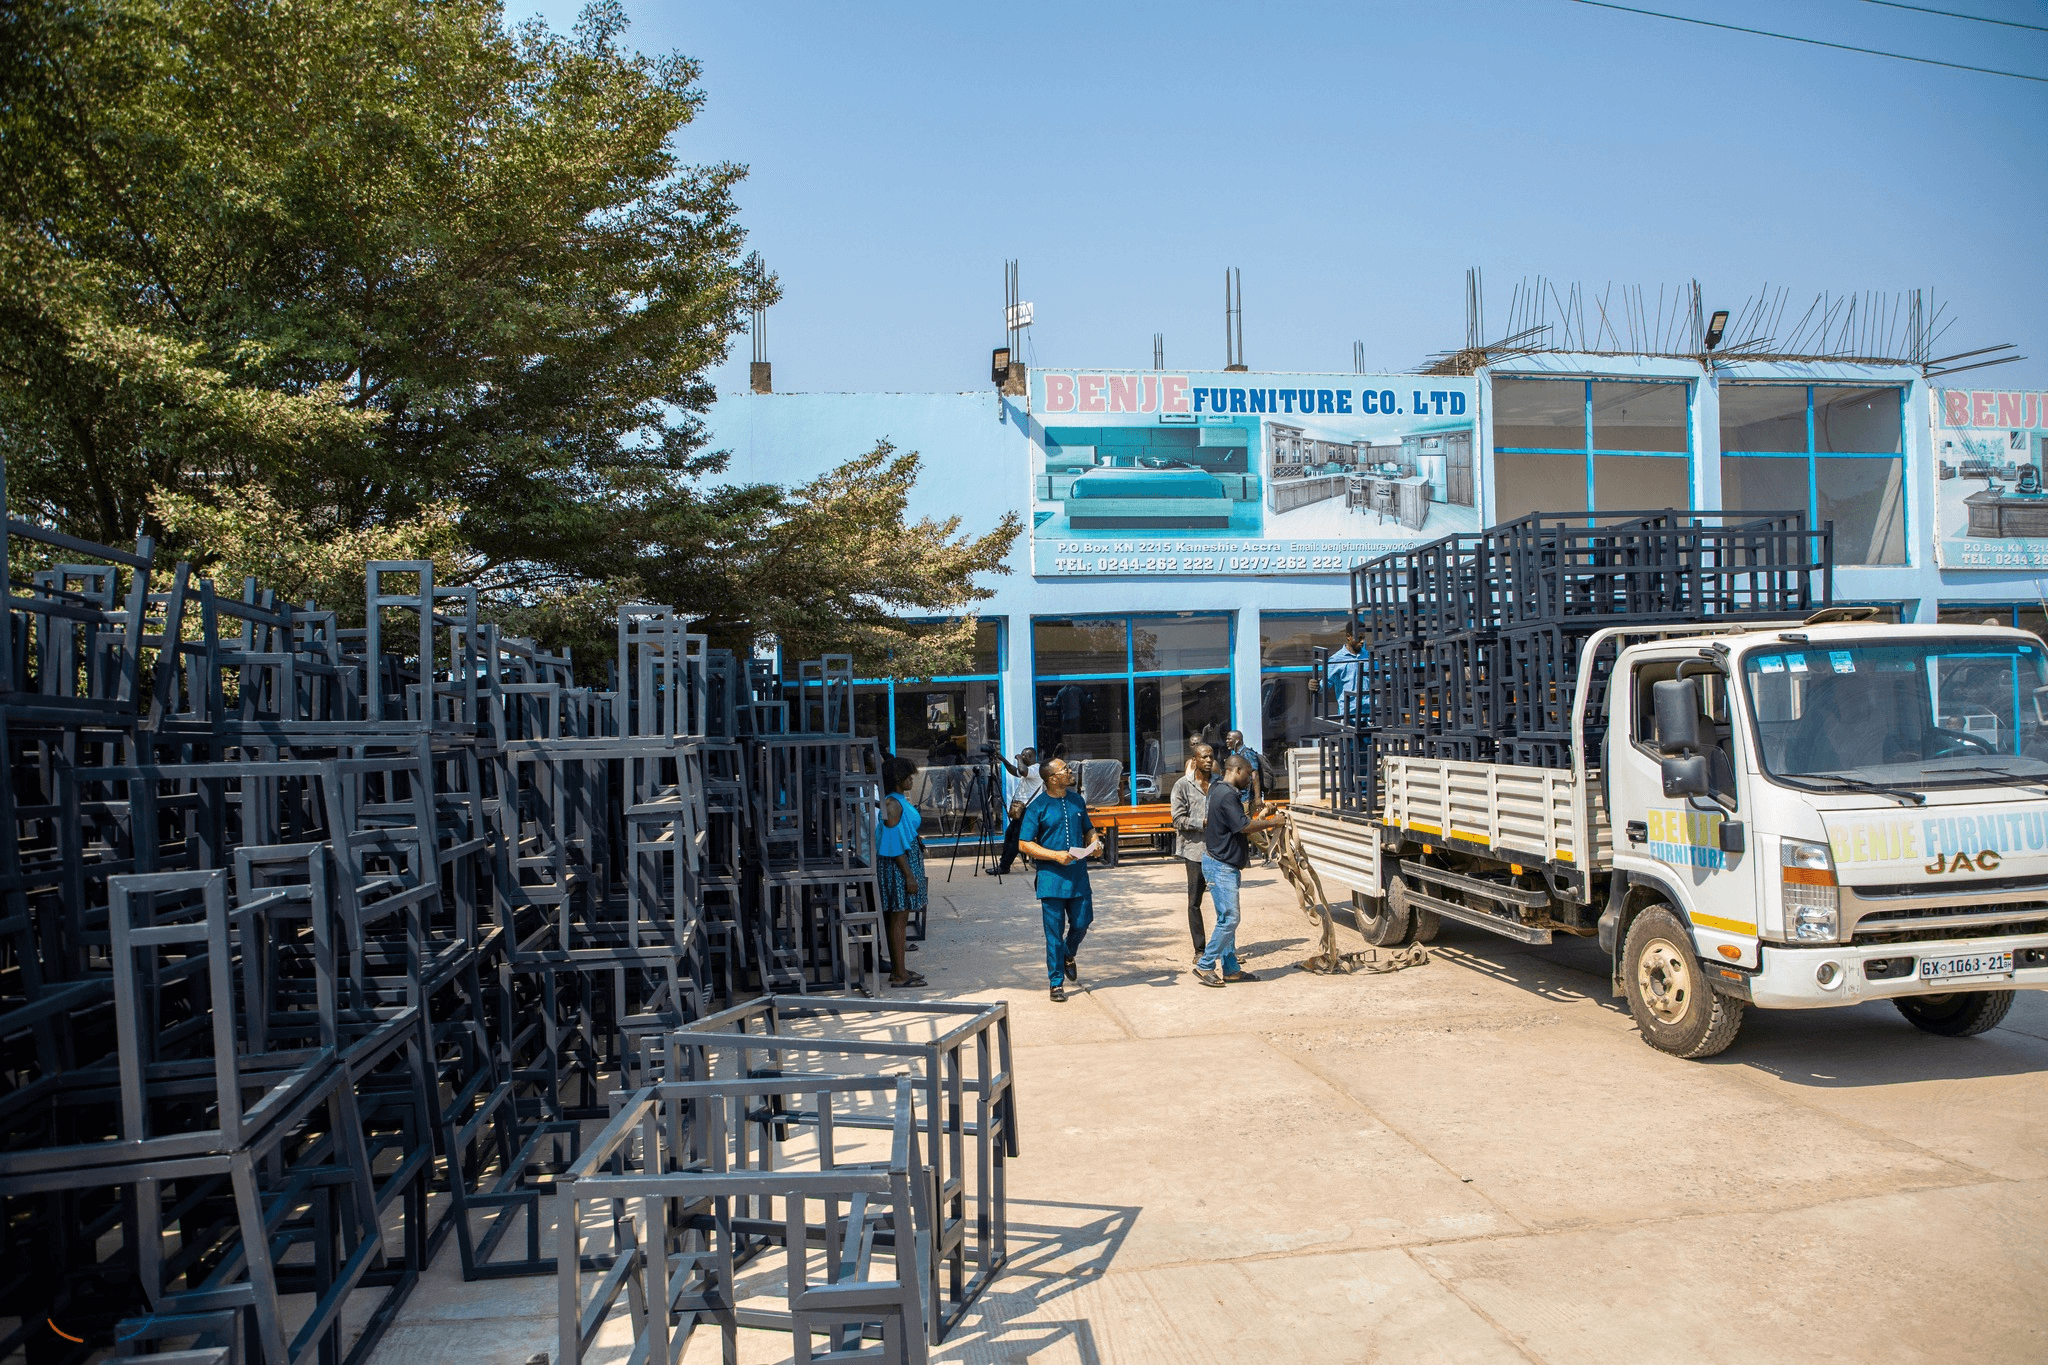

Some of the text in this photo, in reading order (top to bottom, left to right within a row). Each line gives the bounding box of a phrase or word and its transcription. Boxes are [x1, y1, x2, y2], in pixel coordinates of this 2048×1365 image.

[1044, 374, 1466, 415] BENJE FURNITURE CO. LTD
[1057, 542, 1110, 553] P.O.Box
[1114, 542, 1135, 553] KN
[1138, 542, 1172, 553] 2215
[1176, 541, 1239, 552] Kaneshie
[1242, 541, 1282, 552] Accra
[1290, 541, 1320, 553] Email:
[2026, 543, 2048, 553] 221
[1055, 557, 1093, 571] TEL:
[1097, 556, 1179, 571] 0244-262
[1183, 556, 1215, 571] 222
[1230, 555, 1308, 570] 0277-262
[1312, 555, 1344, 570] 222
[1962, 553, 1991, 566] TEL:
[1828, 810, 2048, 864] BENJE FURNITU
[1649, 842, 1728, 870] FURNITURE
[1924, 849, 2002, 875] JAC
